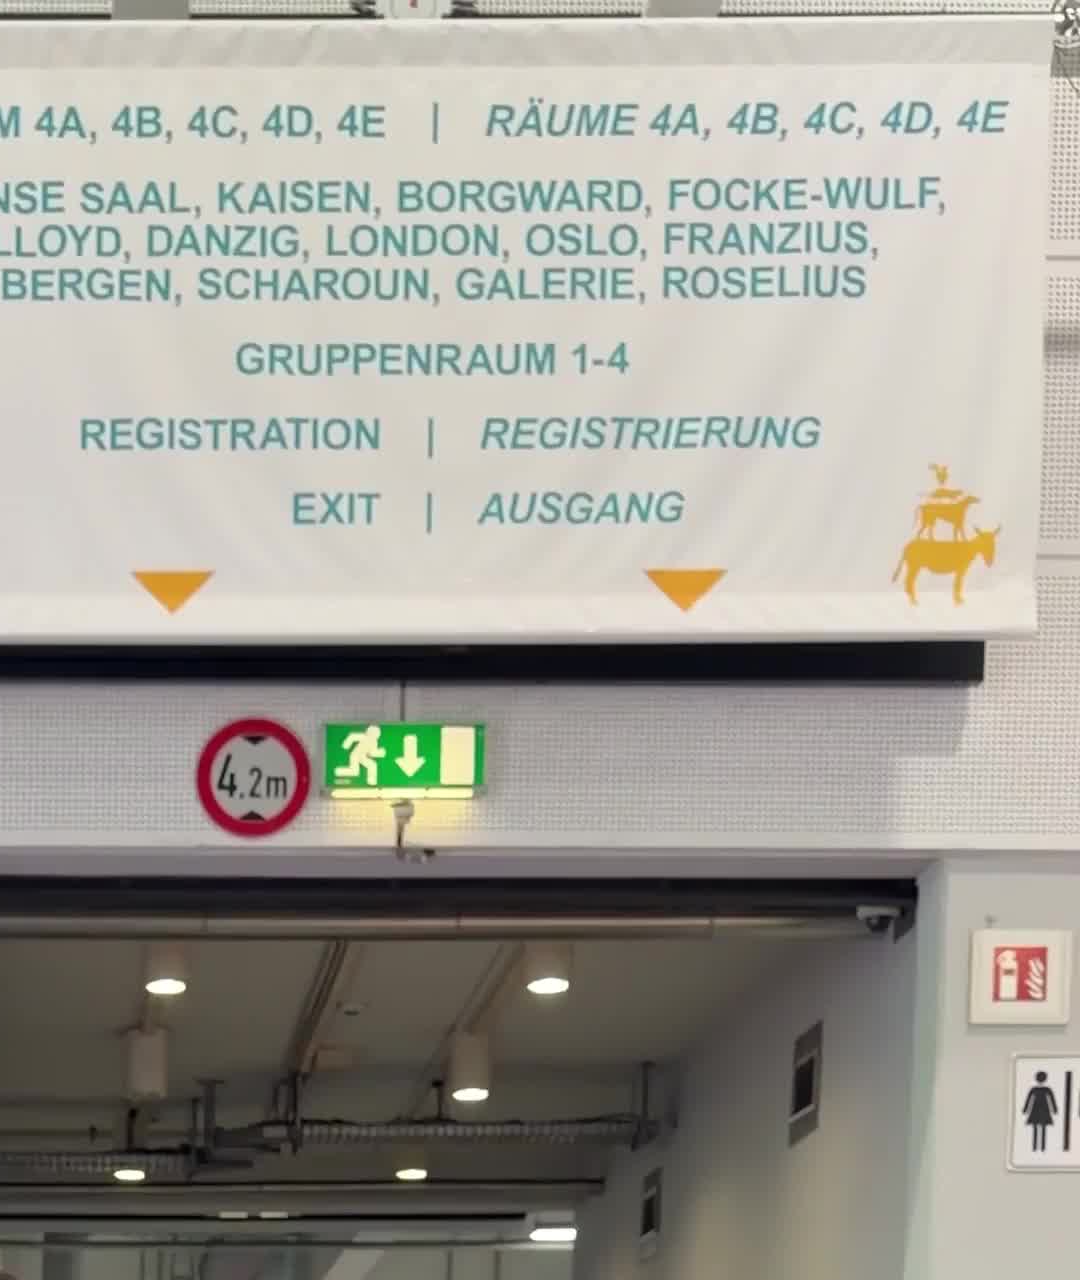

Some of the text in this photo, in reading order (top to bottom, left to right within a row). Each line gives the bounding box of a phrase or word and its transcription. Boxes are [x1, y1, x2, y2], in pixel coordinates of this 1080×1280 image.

[34, 106, 96, 144] 4A,
[111, 105, 172, 144] 4B,
[187, 105, 248, 144] 4C,
[262, 104, 322, 144] 4D,
[336, 104, 386, 138] 4E
[486, 97, 639, 137] RÄUME
[649, 103, 711, 141] 4A,
[726, 102, 788, 141] 4B,
[803, 101, 864, 139] 4C,
[880, 101, 941, 139] 4D,
[956, 100, 1010, 134] 4E
[80, 181, 201, 218] SAAL,
[217, 180, 381, 218] KAISEN,
[397, 179, 651, 218] BORGWARD,
[668, 176, 946, 215] FOCKE-WULF,
[147, 224, 309, 263] DANZIG,
[326, 224, 510, 260] LONDON,
[526, 224, 646, 260] OSLO,
[664, 221, 879, 260] FRANZIUS,
[1, 265, 867, 306] BERGEN, SCHAROUN, GALERIE, ROSELIUS
[236, 342, 630, 377] GRUPPENRAUM 1-4
[80, 417, 381, 451] REGISTRATION
[480, 416, 821, 451] REGISTRIERUNG
[292, 492, 381, 527] EXIT
[477, 491, 685, 526] AUSGANG
